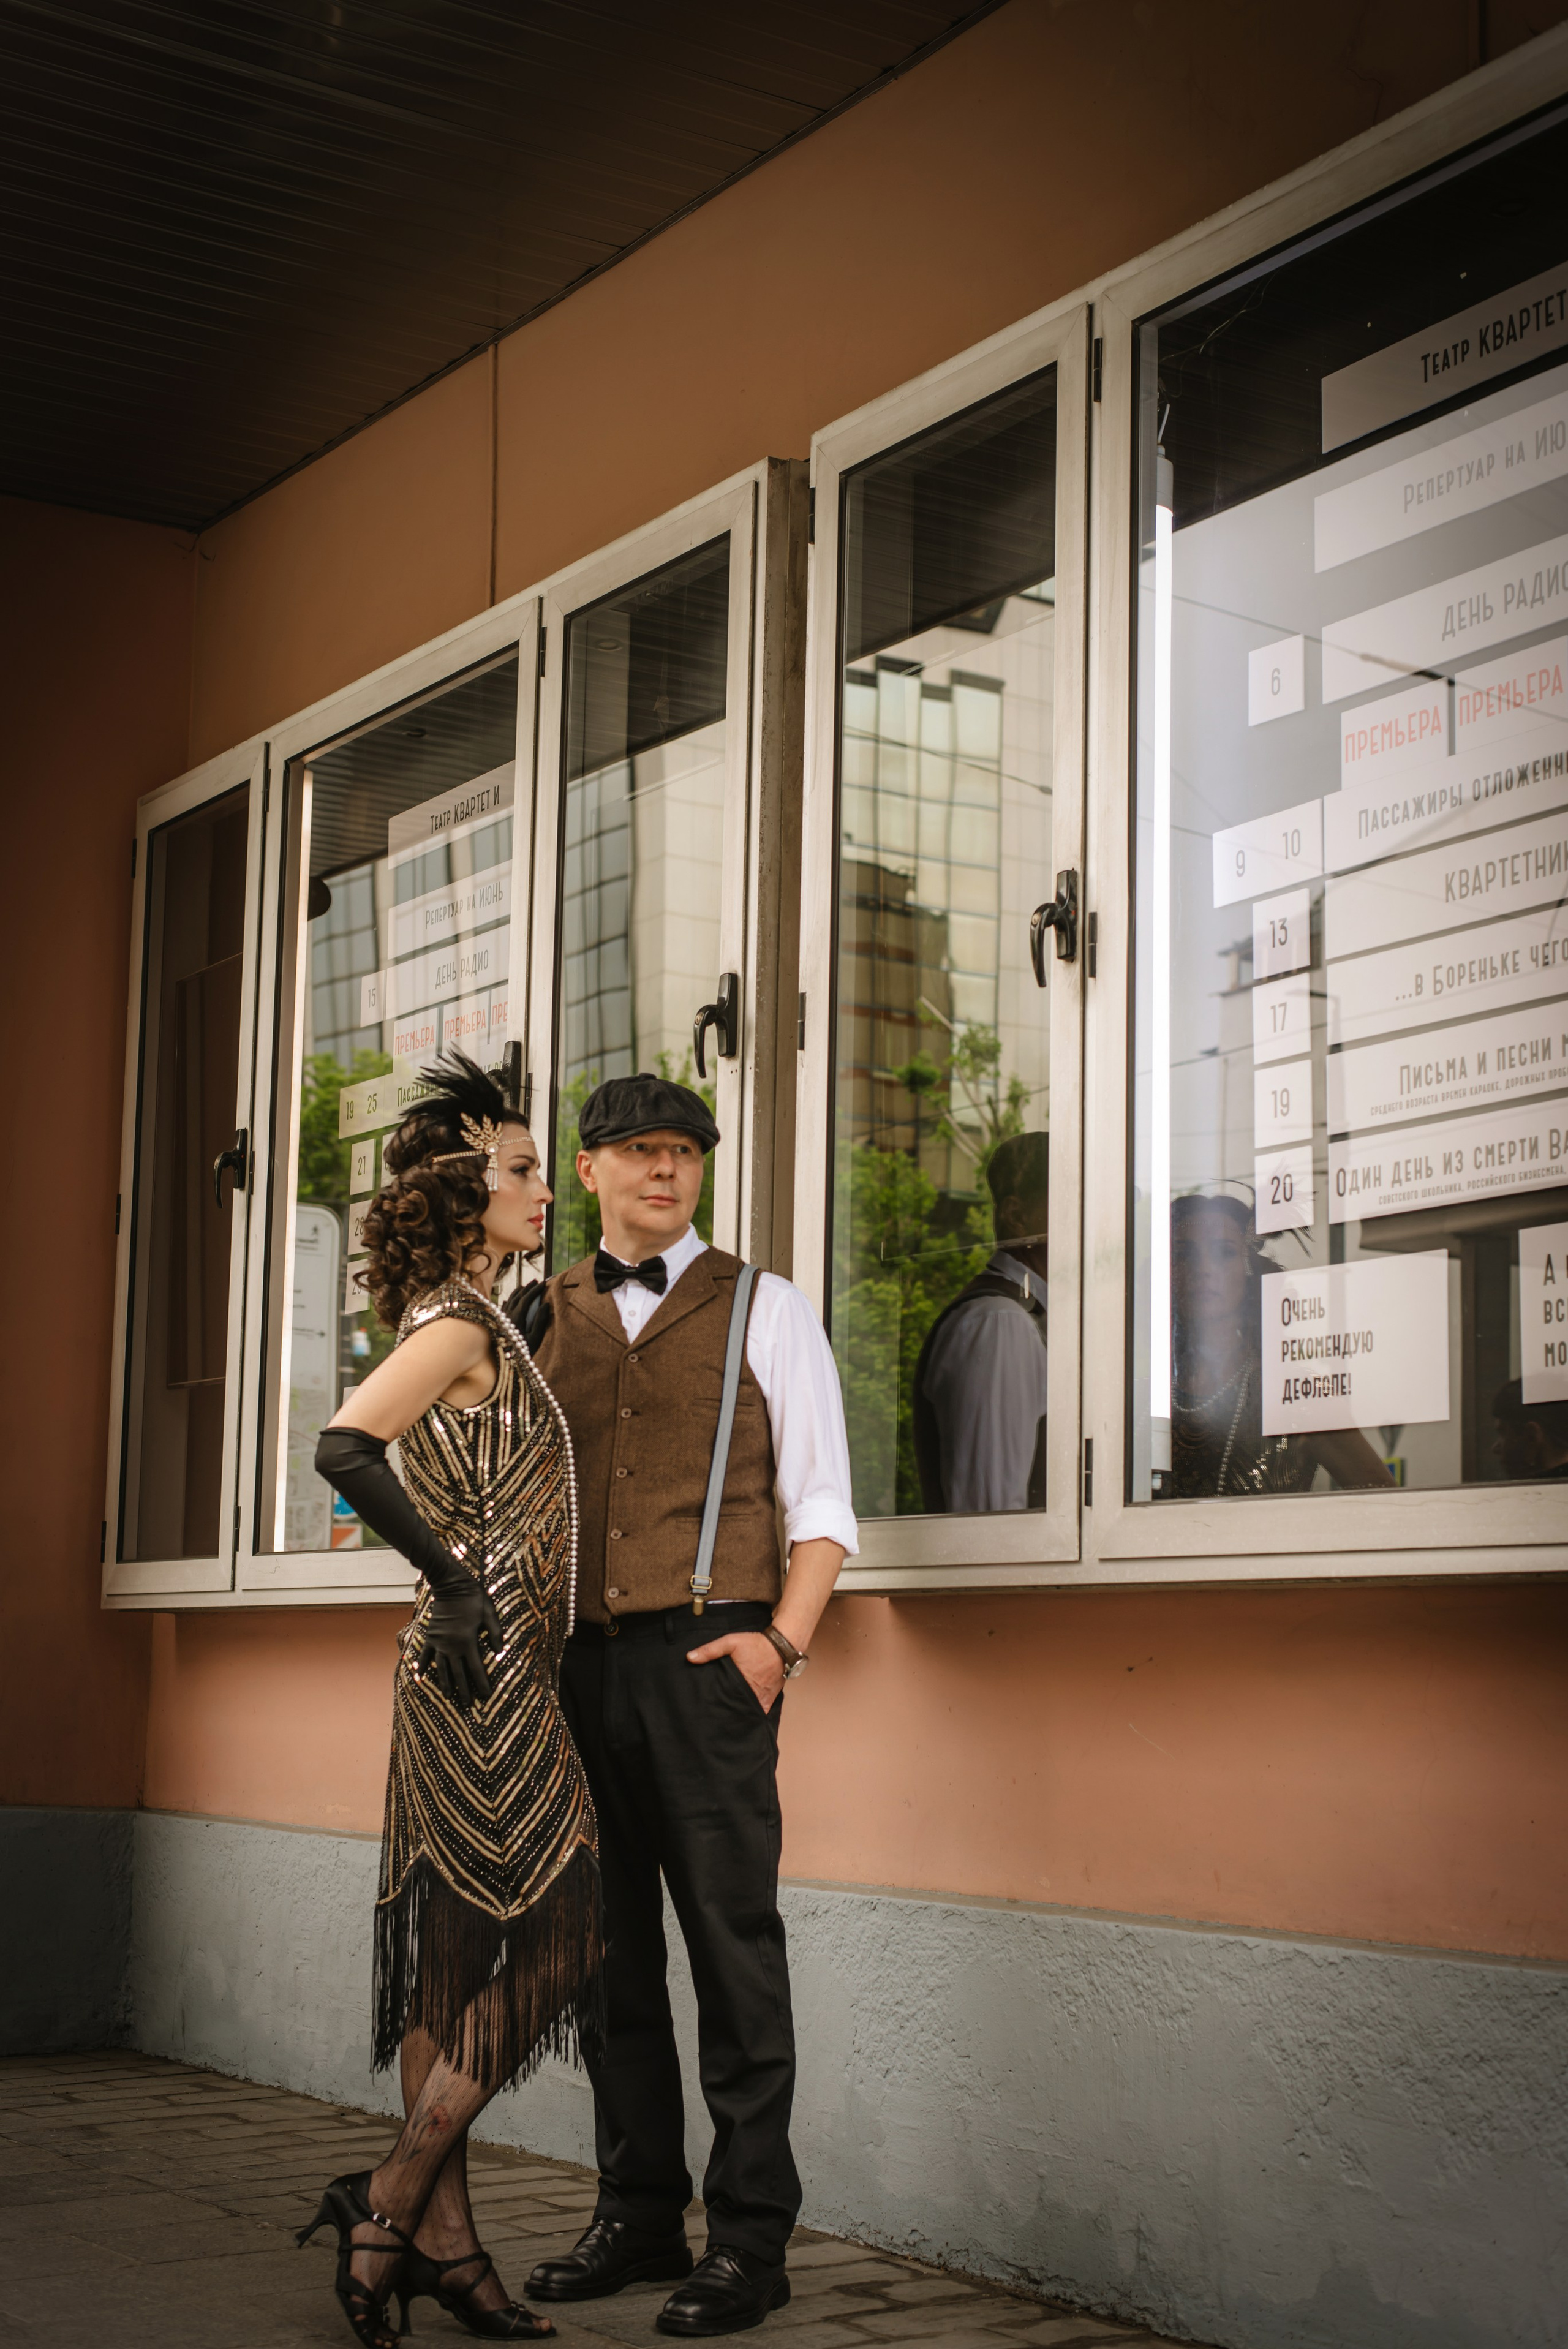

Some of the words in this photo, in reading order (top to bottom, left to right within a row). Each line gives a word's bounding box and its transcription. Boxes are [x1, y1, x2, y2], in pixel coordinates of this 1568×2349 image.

[1479, 288, 1567, 358] КВАРТЕТ
[1404, 453, 1495, 514] РЕПЕРТУАР
[1505, 440, 1525, 469] НА
[1442, 592, 1494, 641] ДЕНЬ
[1270, 668, 1281, 696] 6
[1459, 664, 1564, 726] ПРЕМЬЕРА
[1345, 705, 1442, 764] ПРЕМЬЕРА
[454, 789, 490, 824] КВАРТЕТ
[494, 785, 500, 806] И
[1359, 783, 1463, 839] ПАССАЖИРЫ
[1472, 750, 1568, 802] ОТЛОЖЕНН
[1235, 850, 1246, 878] 9
[1282, 828, 1301, 860] 10
[479, 881, 503, 909] ИЮНЬ
[1270, 917, 1287, 948] 13
[435, 962, 457, 990] ДЕНЬ
[460, 949, 489, 978] РАДИО
[368, 987, 376, 1008] 15
[444, 1009, 486, 1041] ПРЕМЬЕРА
[1270, 1001, 1287, 1033] 17
[394, 1025, 435, 1056] ПРЕМЬЕРА
[1400, 1055, 1468, 1095] ПИСЬМА
[1477, 1051, 1487, 1076] И
[1496, 1036, 1551, 1072] ПЕСНИ
[346, 1100, 354, 1120] 19
[368, 1093, 377, 1114] 25
[1271, 1088, 1290, 1118] 19
[358, 1156, 366, 1176] 21
[1336, 1165, 1381, 1197] ОДИН
[1391, 1156, 1433, 1188] ДЕНЬ
[1443, 1150, 1464, 1175] ИЗ
[1474, 1135, 1539, 1170] СМЕРТИ
[1270, 1173, 1293, 1205] 20
[1544, 1253, 1556, 1286] А
[1281, 1297, 1326, 1327] ОЧЕНЬ
[1544, 1298, 1568, 1324] ВС
[1281, 1330, 1374, 1362] РЕКОМЕНДУЮ
